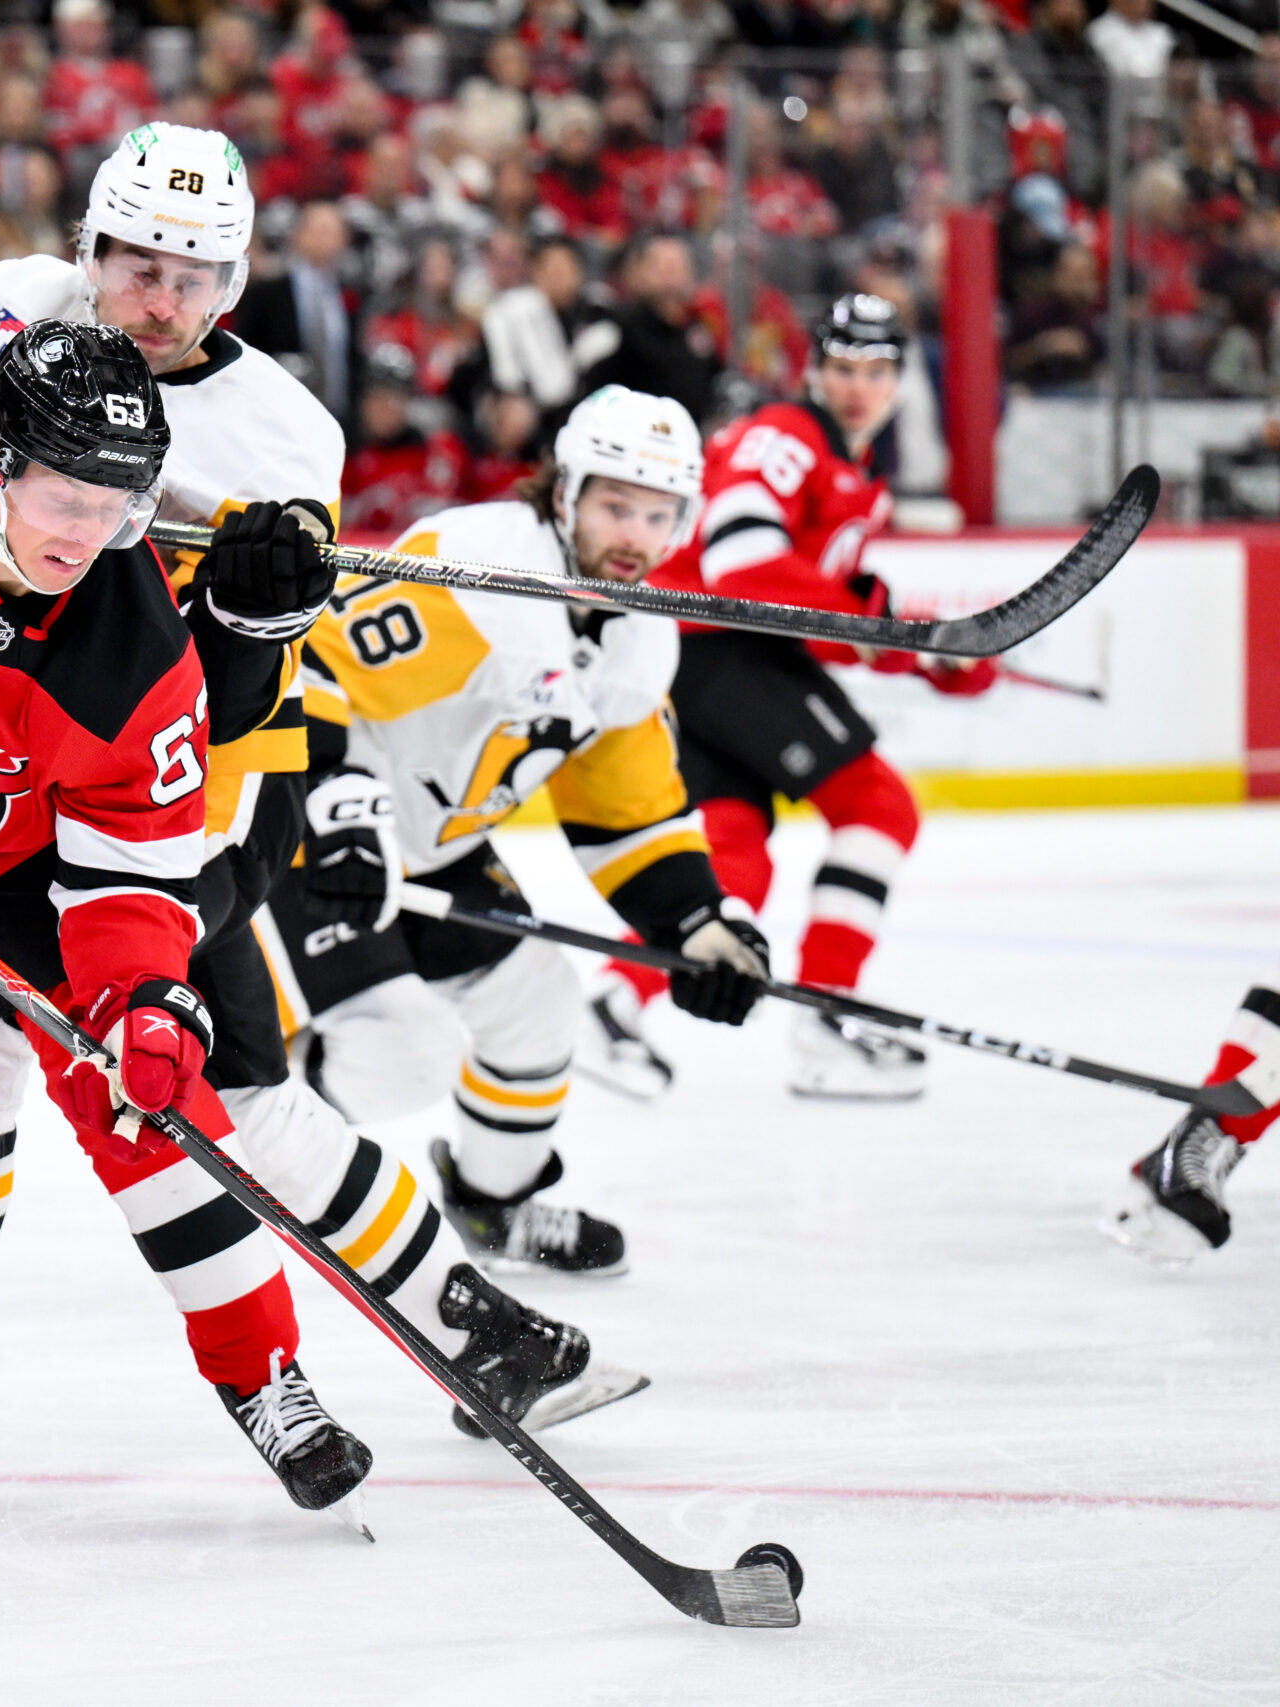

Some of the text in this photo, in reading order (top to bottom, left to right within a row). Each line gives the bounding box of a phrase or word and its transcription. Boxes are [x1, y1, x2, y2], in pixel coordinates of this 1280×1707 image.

[168, 168, 204, 195] 28
[106, 393, 147, 429] 63
[506, 1443, 599, 1524] FLYLITE
